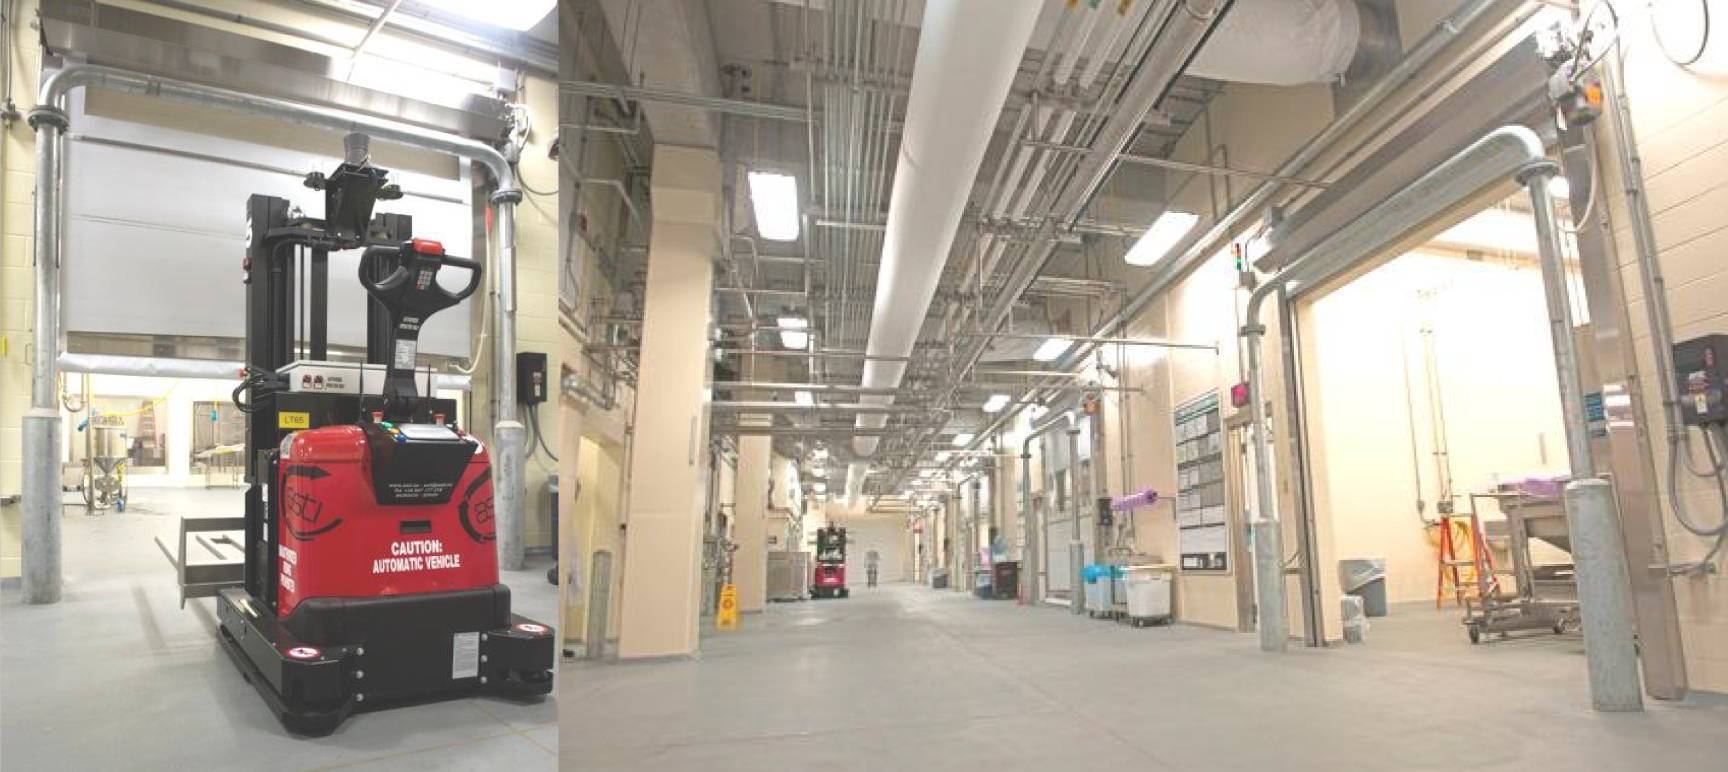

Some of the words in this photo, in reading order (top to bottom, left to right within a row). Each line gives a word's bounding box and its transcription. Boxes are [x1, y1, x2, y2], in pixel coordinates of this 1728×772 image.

[391, 540, 443, 556] CAUTION:
[372, 557, 424, 574] AUTOMATIC
[425, 554, 461, 570] VEHICLE
